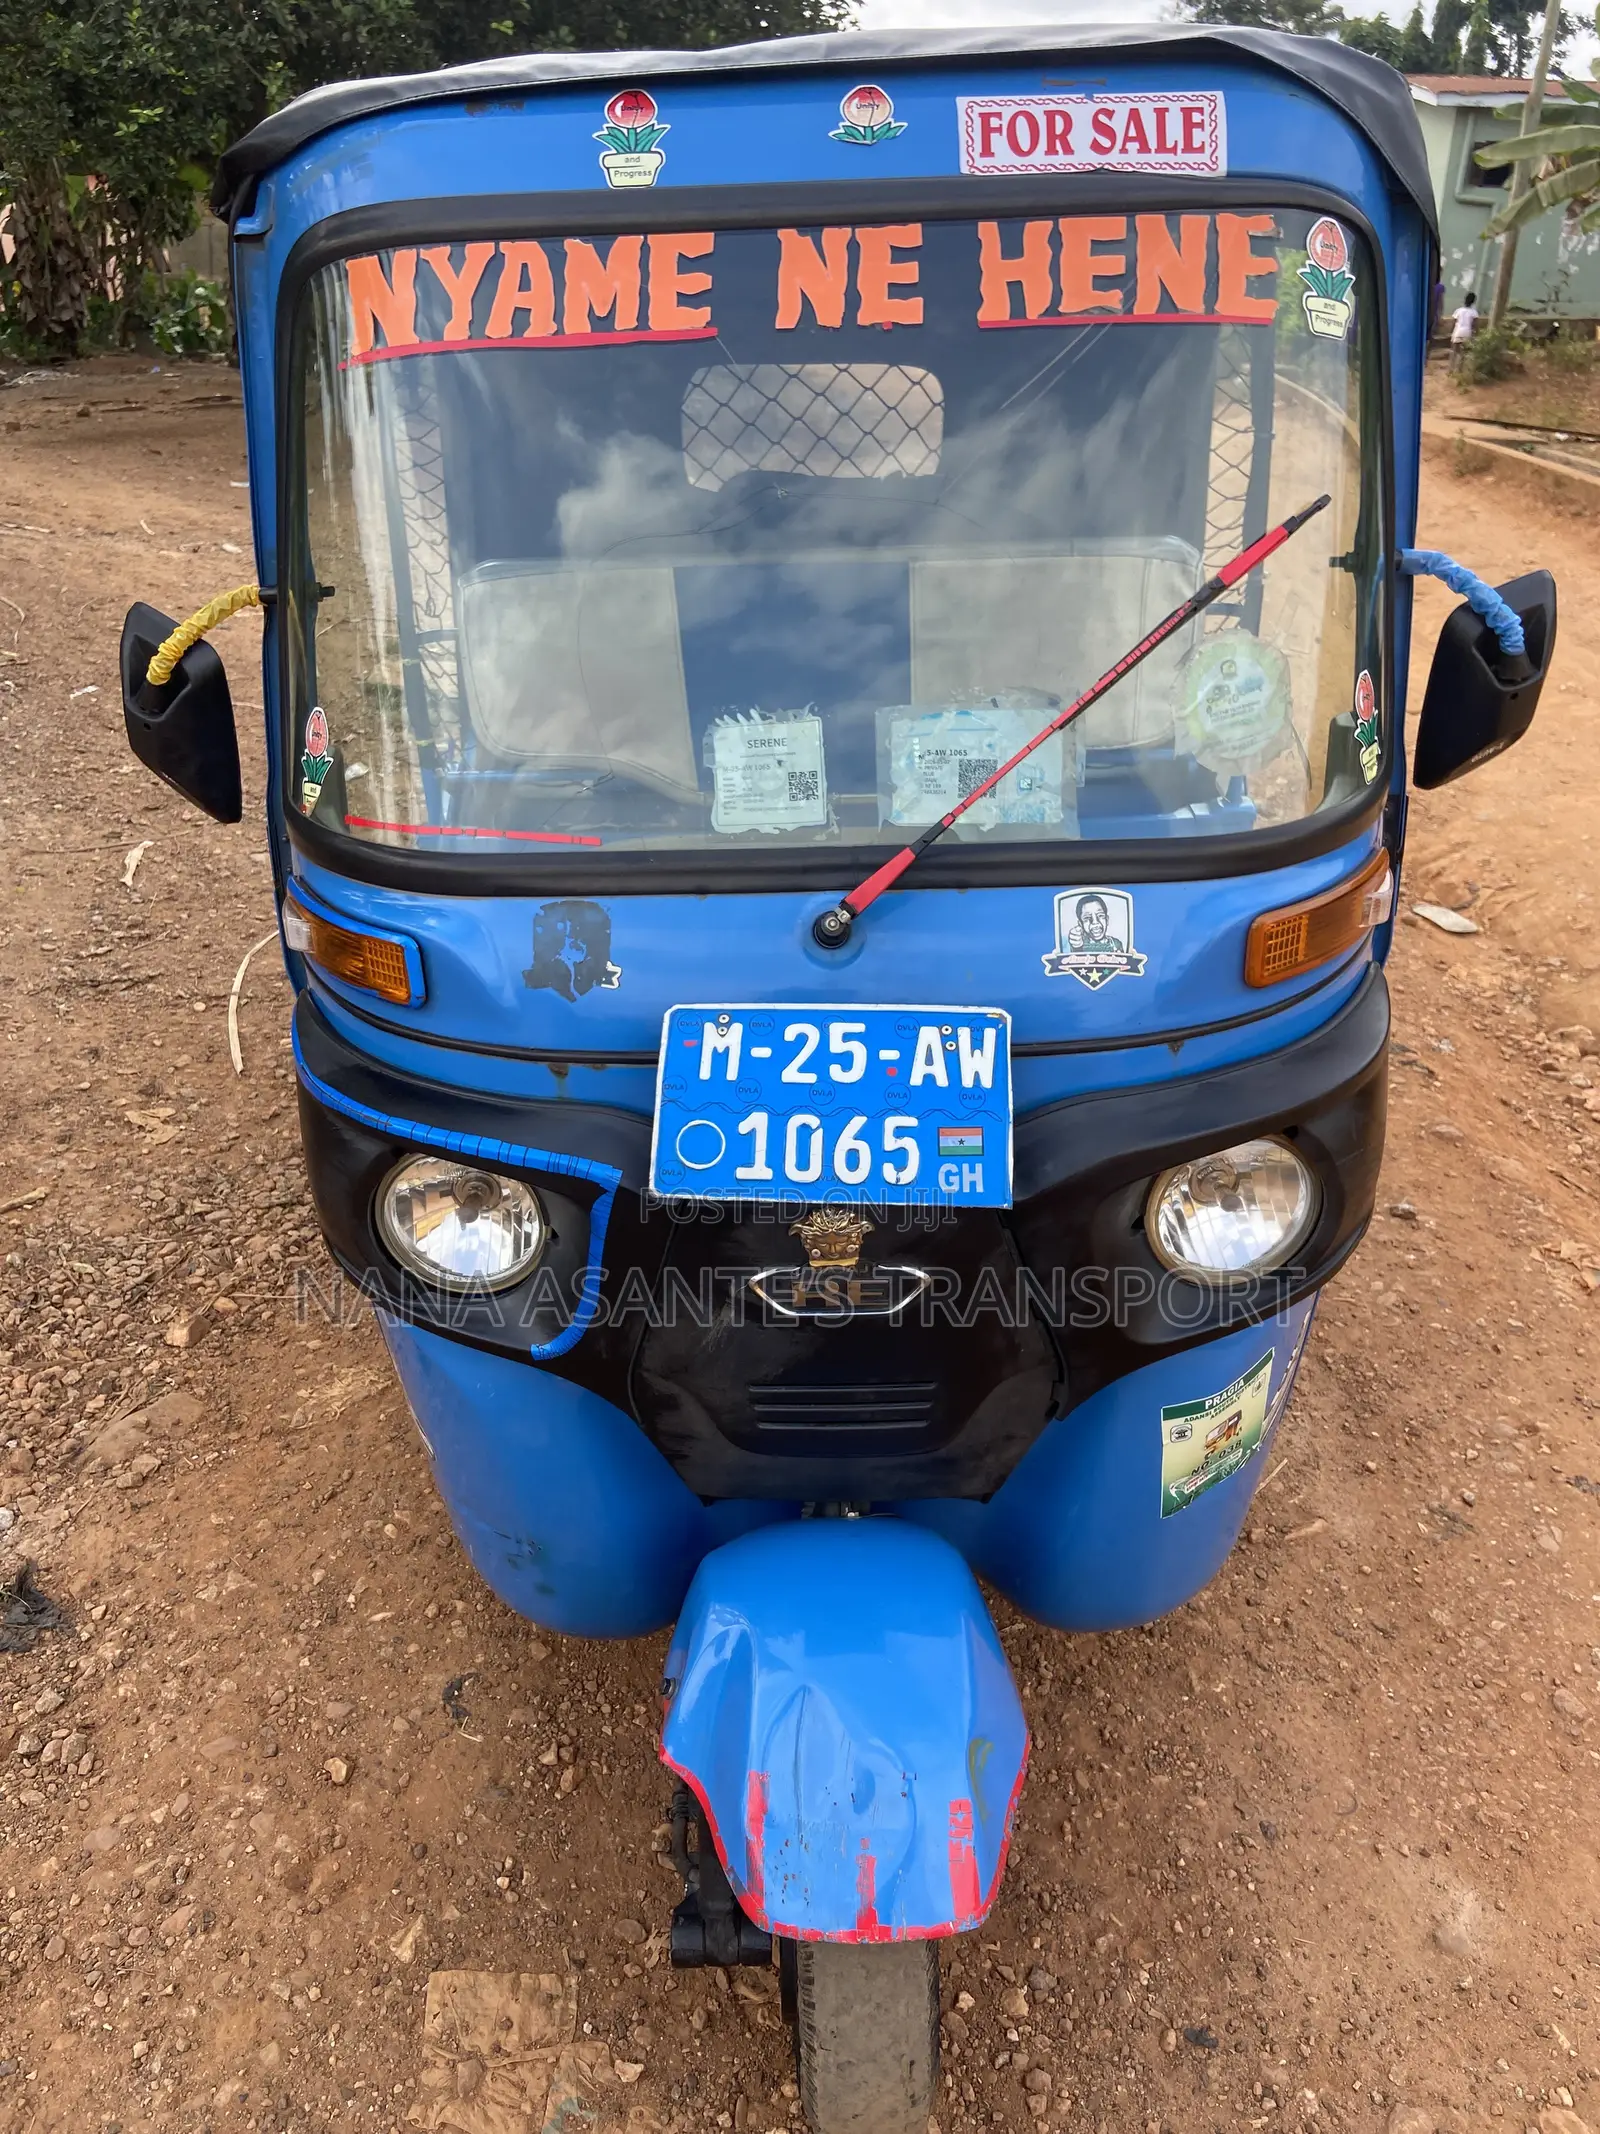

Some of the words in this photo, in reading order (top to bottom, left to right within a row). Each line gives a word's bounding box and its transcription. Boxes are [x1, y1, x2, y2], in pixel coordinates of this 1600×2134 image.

[978, 110, 1075, 158] FOR
[1089, 105, 1206, 155] SALE
[614, 170, 652, 178] Progress
[345, 232, 715, 356] NYAME
[775, 222, 924, 329] NE
[977, 212, 1279, 320] HENE
[1323, 302, 1336, 310] and
[747, 738, 788, 749] SERENE
[679, 1020, 701, 1028] DVLA
[751, 1020, 773, 1028] DVLA
[699, 1021, 997, 1089] M-25-AW
[663, 1083, 686, 1091] DVLA
[738, 1086, 760, 1095] DVLA
[812, 1088, 834, 1097] DVLA
[887, 1091, 909, 1100] DVLA
[961, 1093, 983, 1102] DVLA
[735, 1112, 921, 1185] 1065
[661, 1168, 684, 1177] DVLA
[938, 1163, 985, 1193] GH
[1205, 1379, 1245, 1410] PRAGIA
[1184, 1411, 1212, 1423] ADANSI
